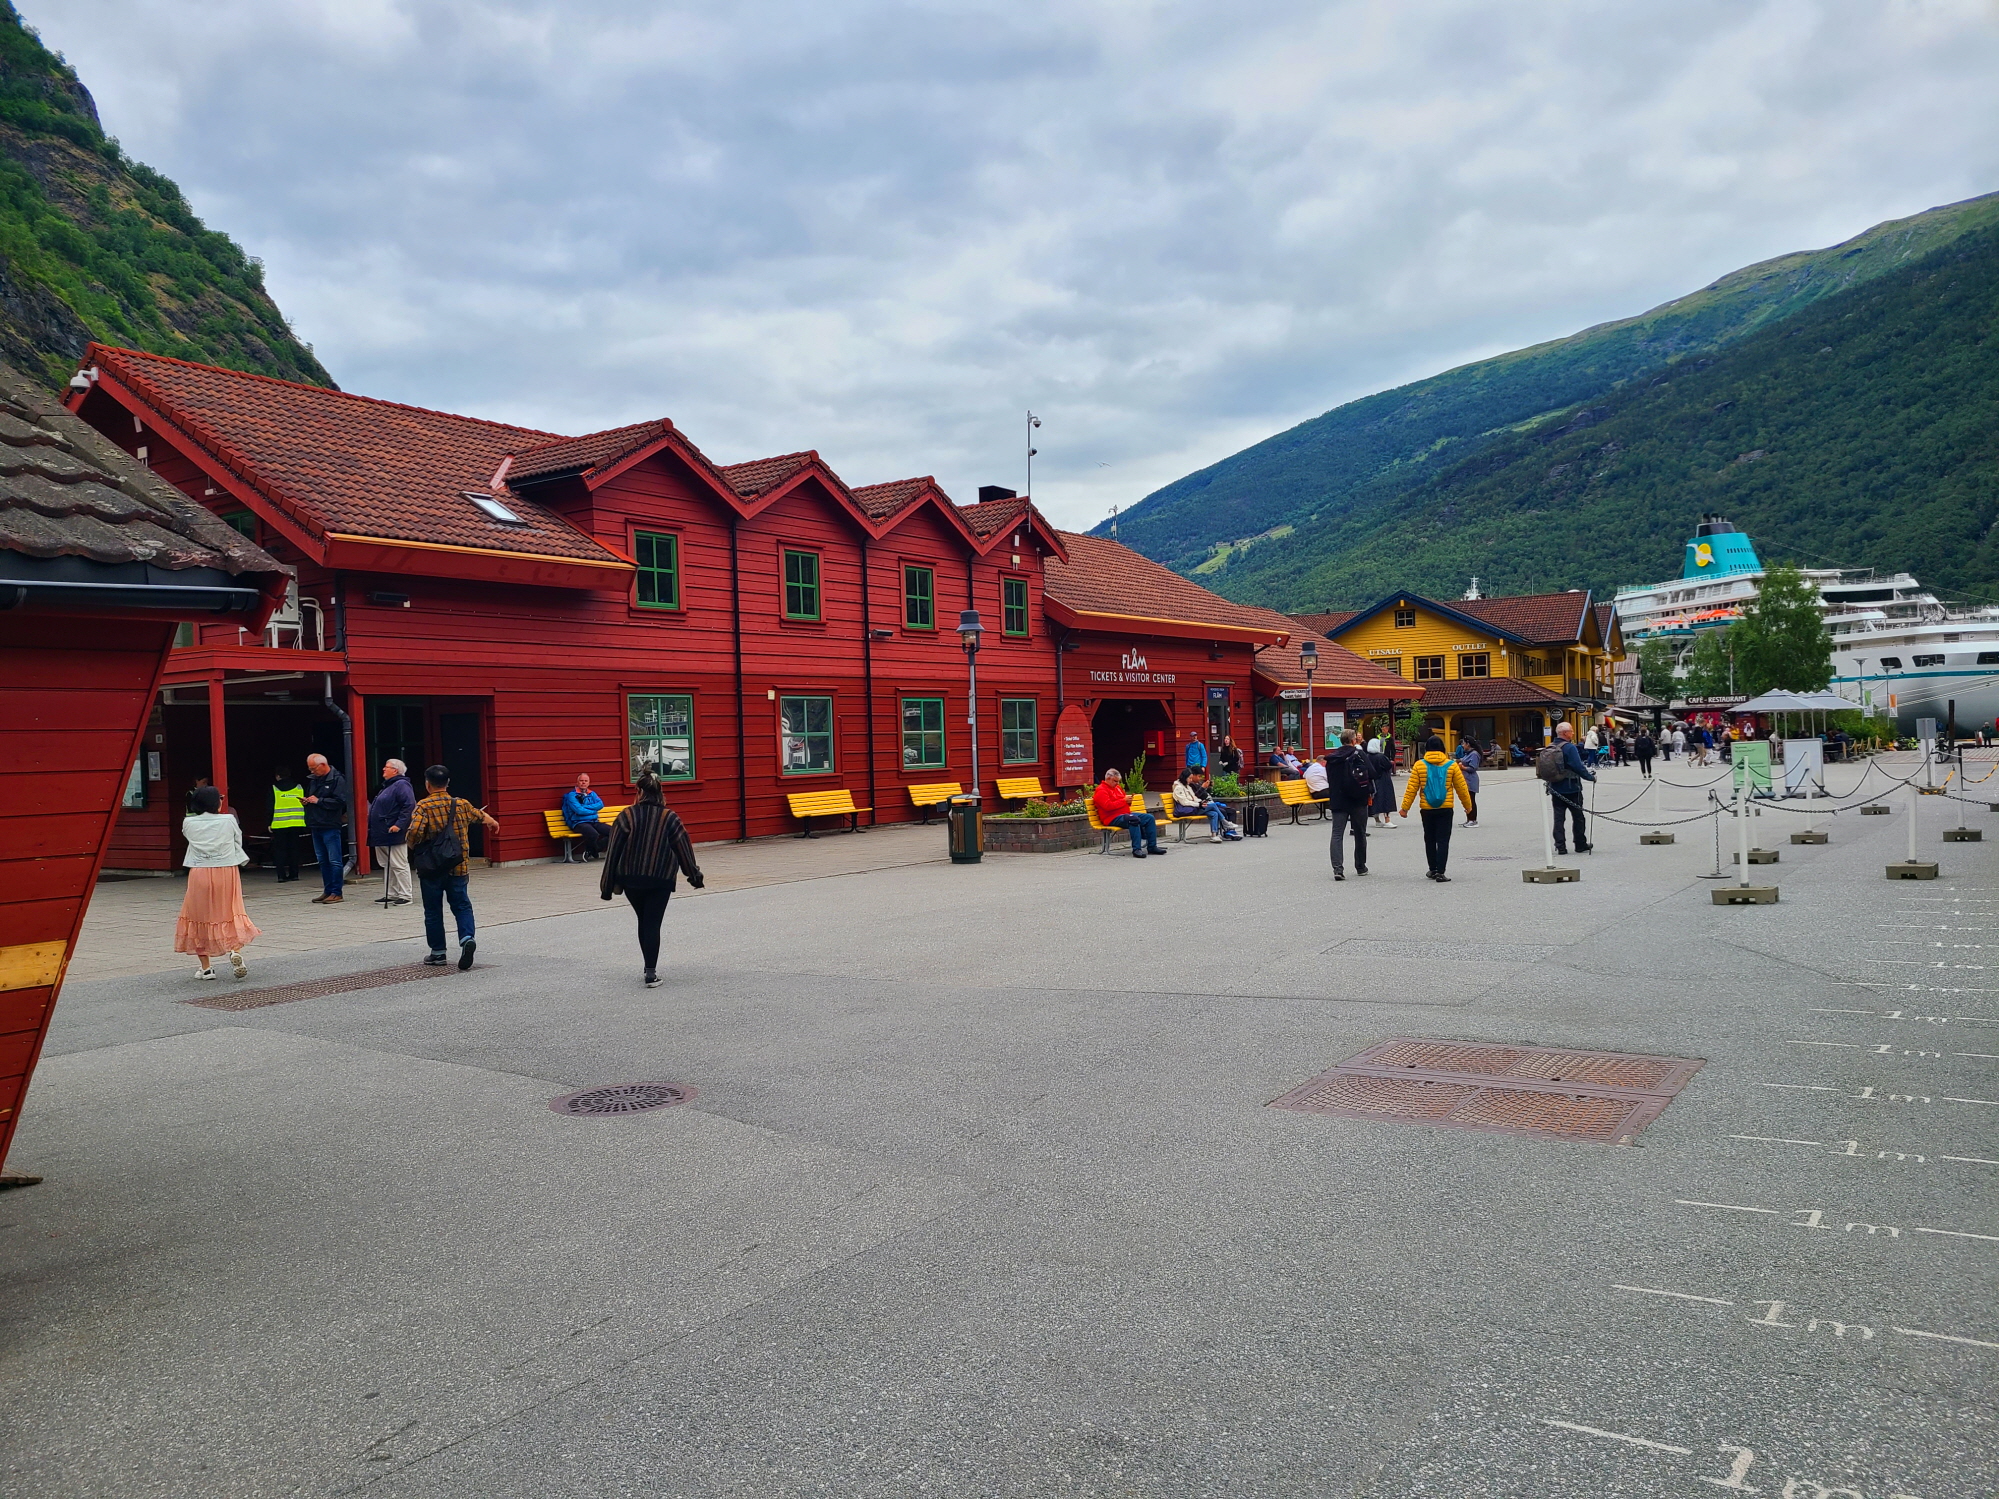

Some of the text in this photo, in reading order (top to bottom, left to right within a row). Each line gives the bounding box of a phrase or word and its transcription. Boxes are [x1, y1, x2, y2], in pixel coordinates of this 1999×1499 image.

[1452, 642, 1487, 651] OUTLET
[1368, 648, 1402, 656] UTSALG
[1122, 647, 1148, 670] FLÅM
[1090, 671, 1176, 684] TICKETS & VISITOR CENTER
[1708, 695, 1747, 703] RESTAURANT
